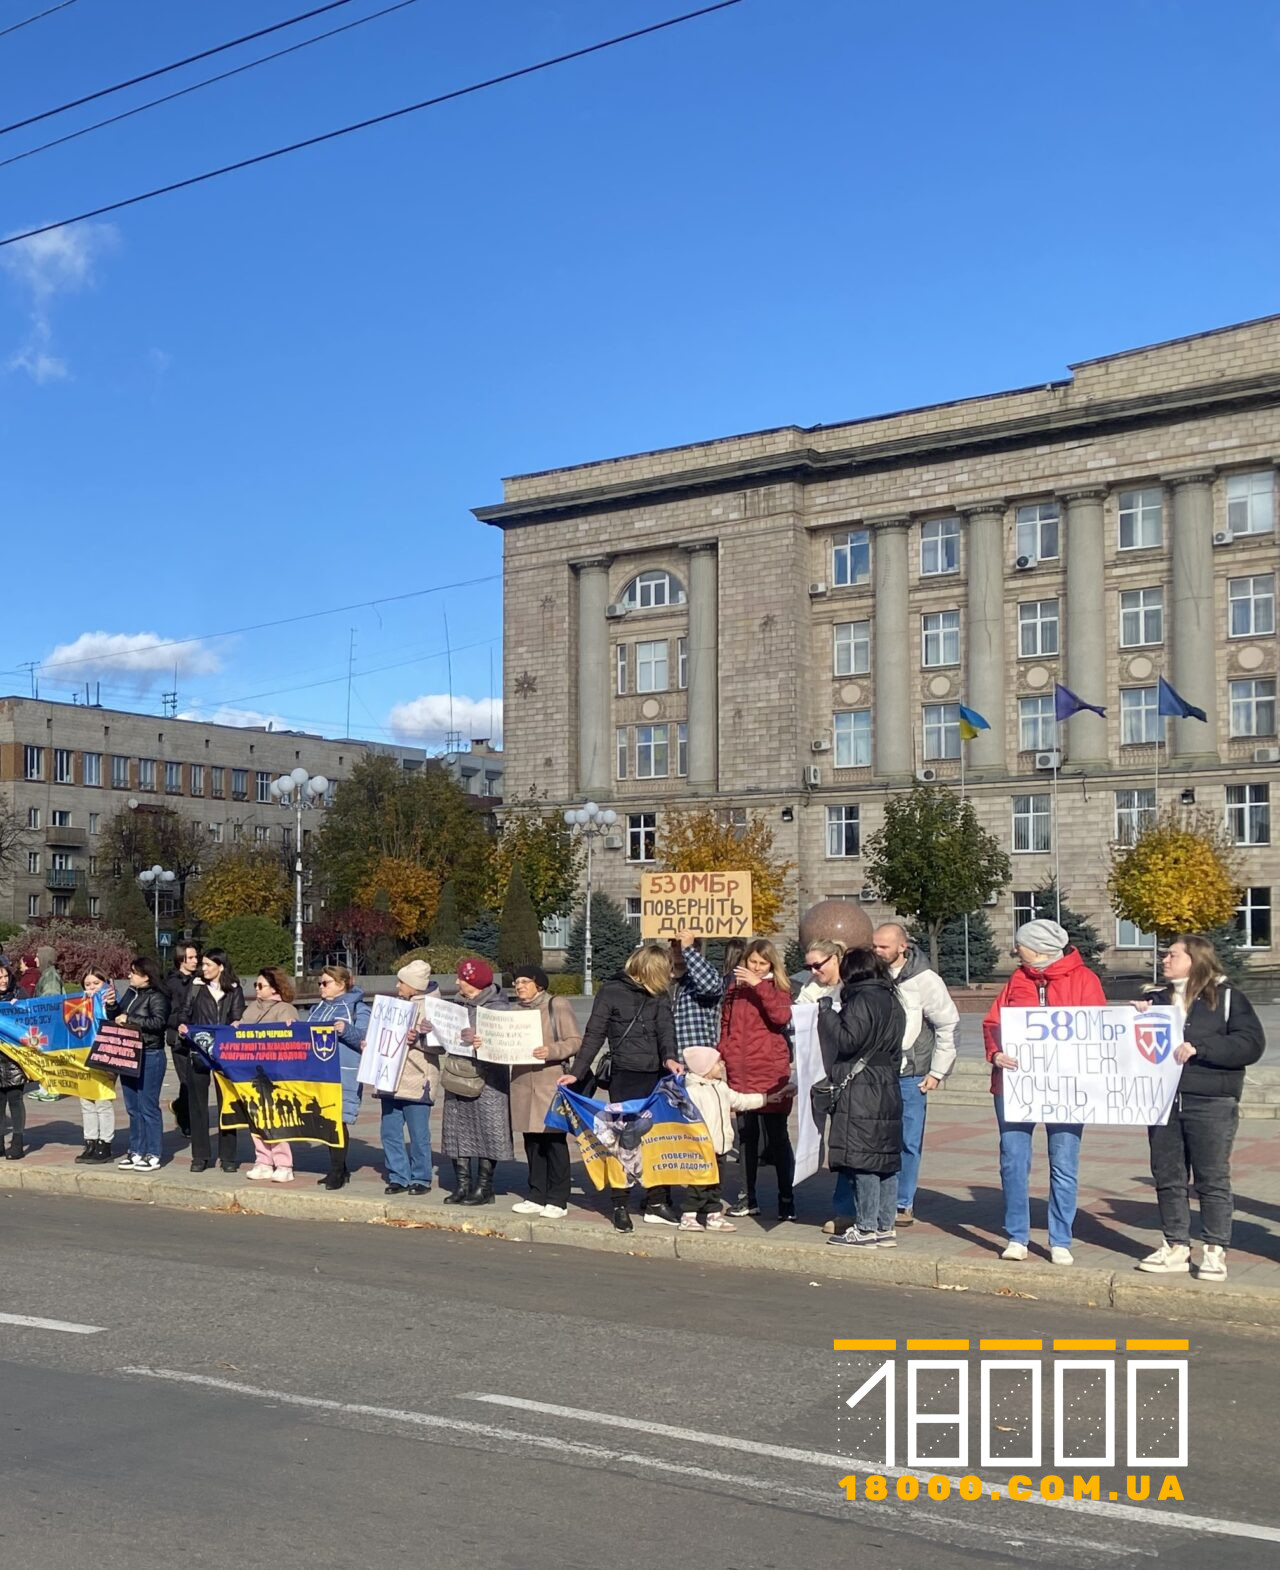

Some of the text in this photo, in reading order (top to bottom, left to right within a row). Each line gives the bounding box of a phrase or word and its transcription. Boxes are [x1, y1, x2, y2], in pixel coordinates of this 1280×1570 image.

[650, 875, 676, 893] 53
[658, 916, 749, 935] ДОДОМУ
[1006, 1043, 1118, 1074] ВОНИ ТЕЖ
[1007, 1075, 1165, 1107] ХОЧУТЬ ЖИТИ
[1041, 1103, 1096, 1123] РОКИ
